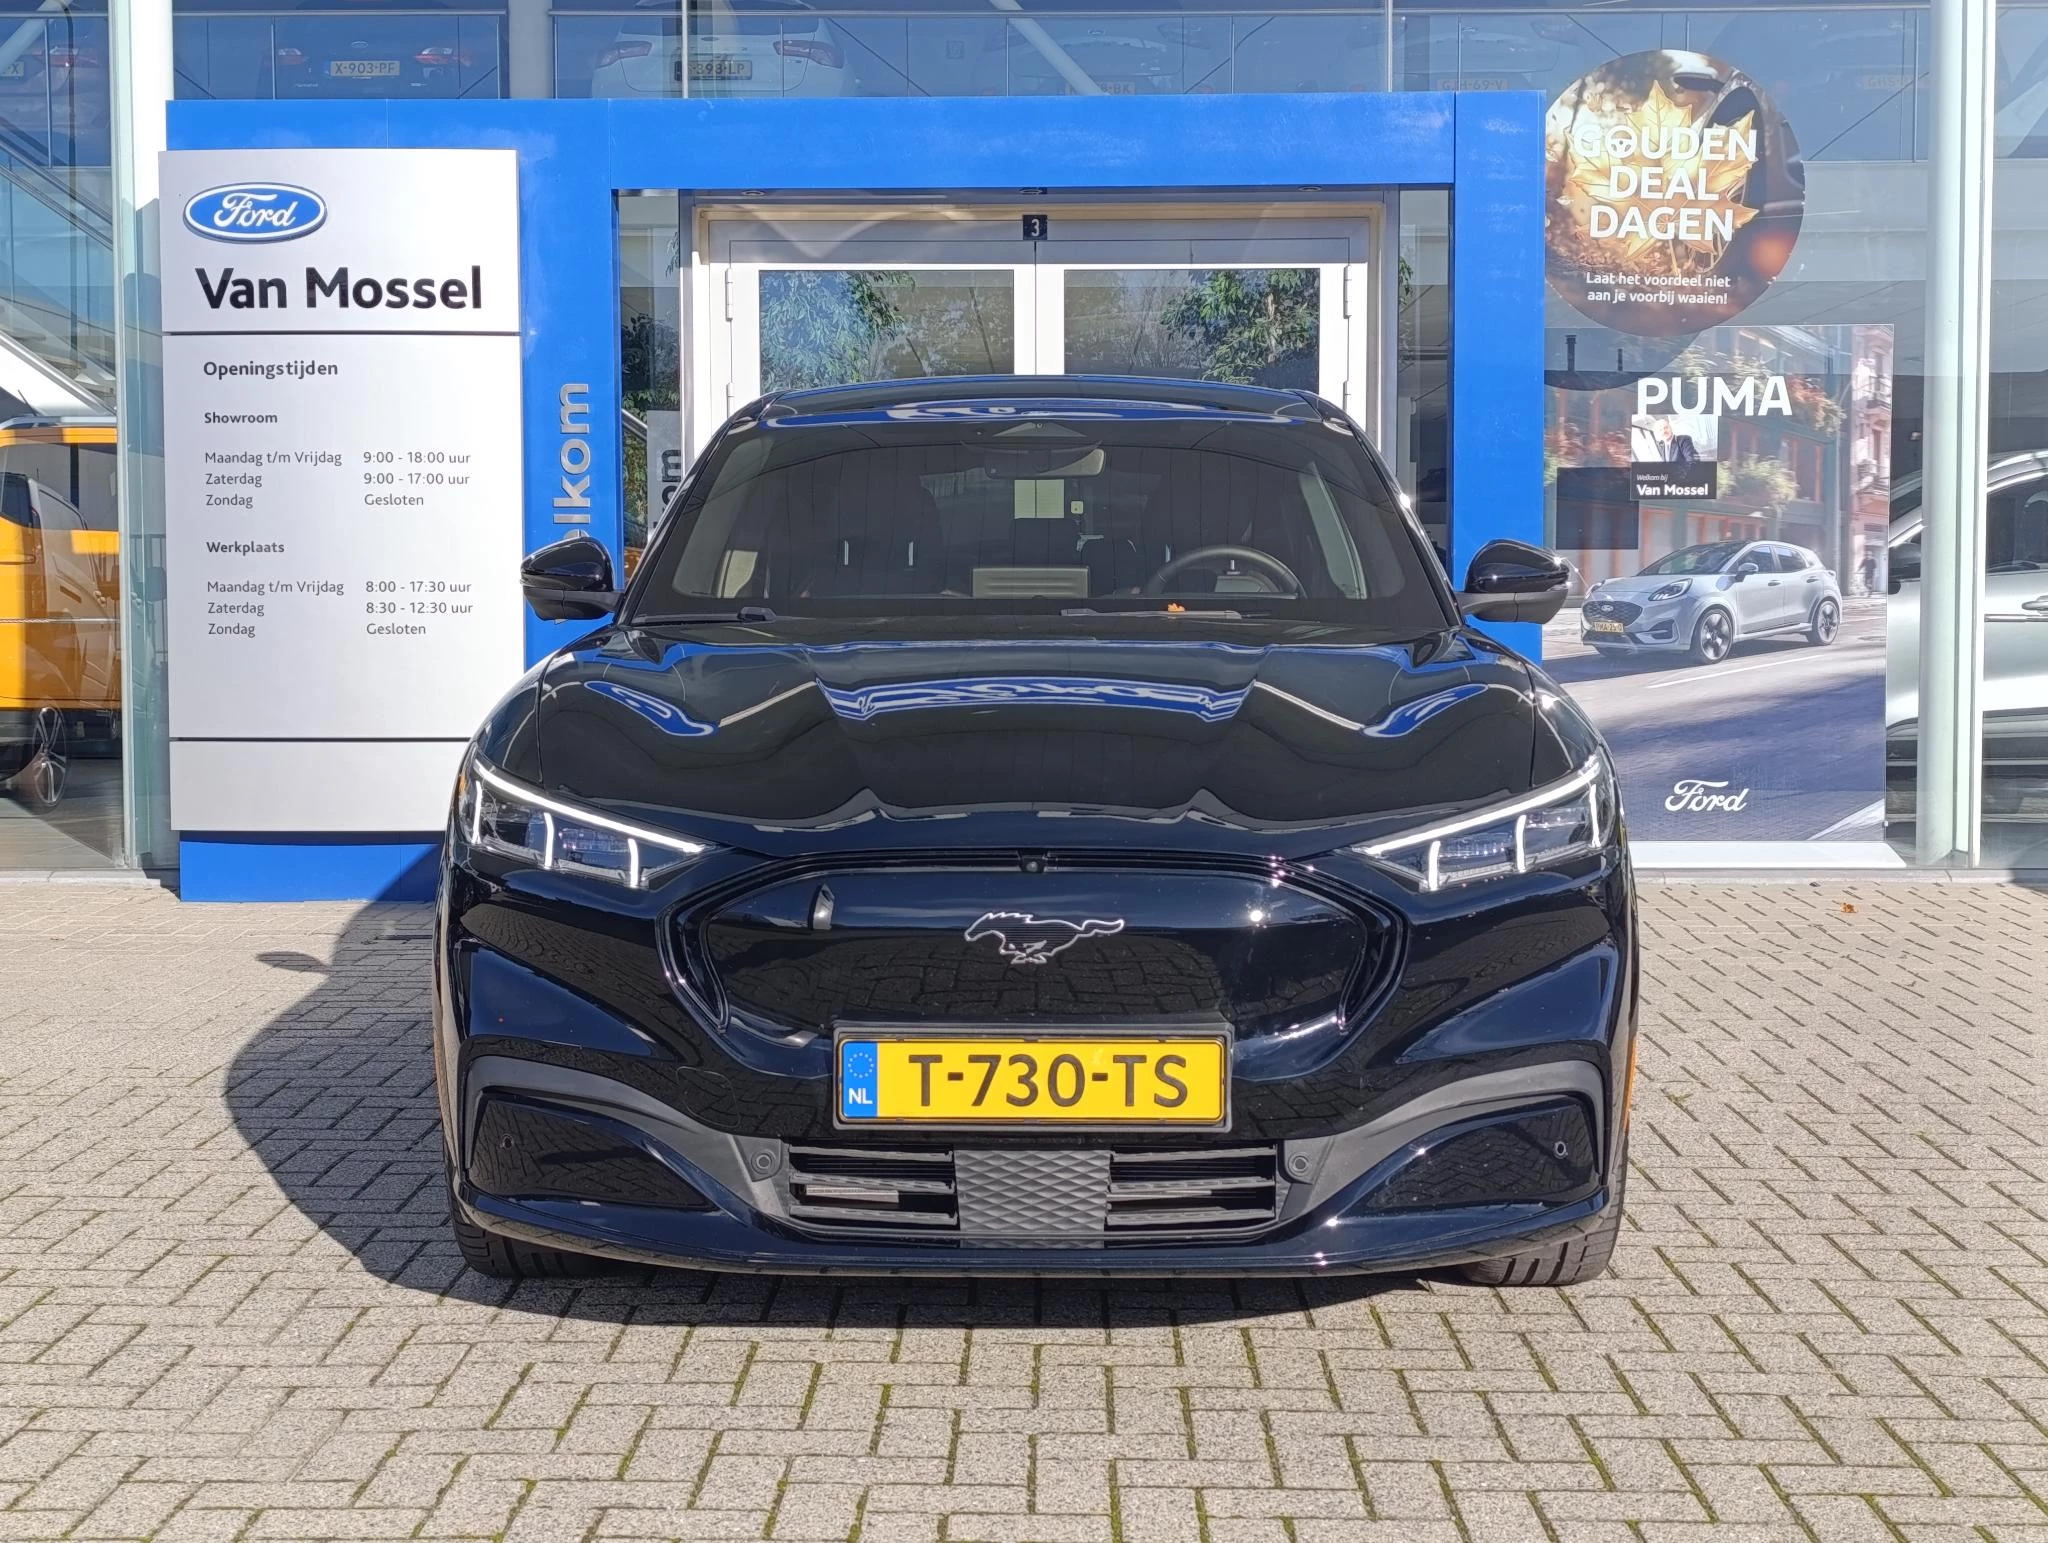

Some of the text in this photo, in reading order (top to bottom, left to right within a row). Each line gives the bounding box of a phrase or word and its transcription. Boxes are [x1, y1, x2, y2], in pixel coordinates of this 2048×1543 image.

[335, 62, 396, 74] X-903-PF
[1573, 124, 1758, 161] GOUDEN
[1608, 165, 1719, 201] DEAL
[213, 192, 298, 227] Ford
[1031, 218, 1040, 237] 3
[1589, 205, 1733, 241] DAGEN
[195, 265, 482, 309] Van Mossel
[1586, 272, 1731, 288] Laat het voordeel niet
[1587, 290, 1728, 305] aan je voorbij waaien!
[203, 361, 339, 380] Openingstijden
[1637, 376, 1793, 416] PUMA
[204, 412, 278, 424] Showroom
[204, 451, 263, 466] Maandag
[267, 451, 291, 464] t/m
[294, 451, 343, 466] Vrijdag
[363, 452, 394, 464] 9:00
[407, 452, 445, 464] 18:00
[448, 454, 471, 464] uur
[205, 473, 262, 487] Zaterdag
[363, 473, 394, 485] 9:00
[407, 473, 444, 485] 17:00
[448, 475, 470, 485] uur
[1636, 483, 1709, 496] Van Mossel
[205, 493, 424, 509] Zondag Gesloten
[206, 541, 285, 556] Werkplaats
[207, 581, 266, 595] Maandag
[268, 580, 293, 593] t/m
[296, 580, 345, 596] Vrijdag
[365, 581, 397, 593] 8:00
[409, 581, 446, 593] 17:30
[449, 583, 472, 593] uur
[207, 602, 265, 617] Zaterdag
[365, 602, 397, 614] 8:30
[409, 602, 447, 614] 12:30
[450, 604, 474, 614] uur
[208, 622, 427, 638] Zondag Gesloten
[1664, 779, 1750, 812] Ford
[848, 1053, 1189, 1108] NL T-730-TS
